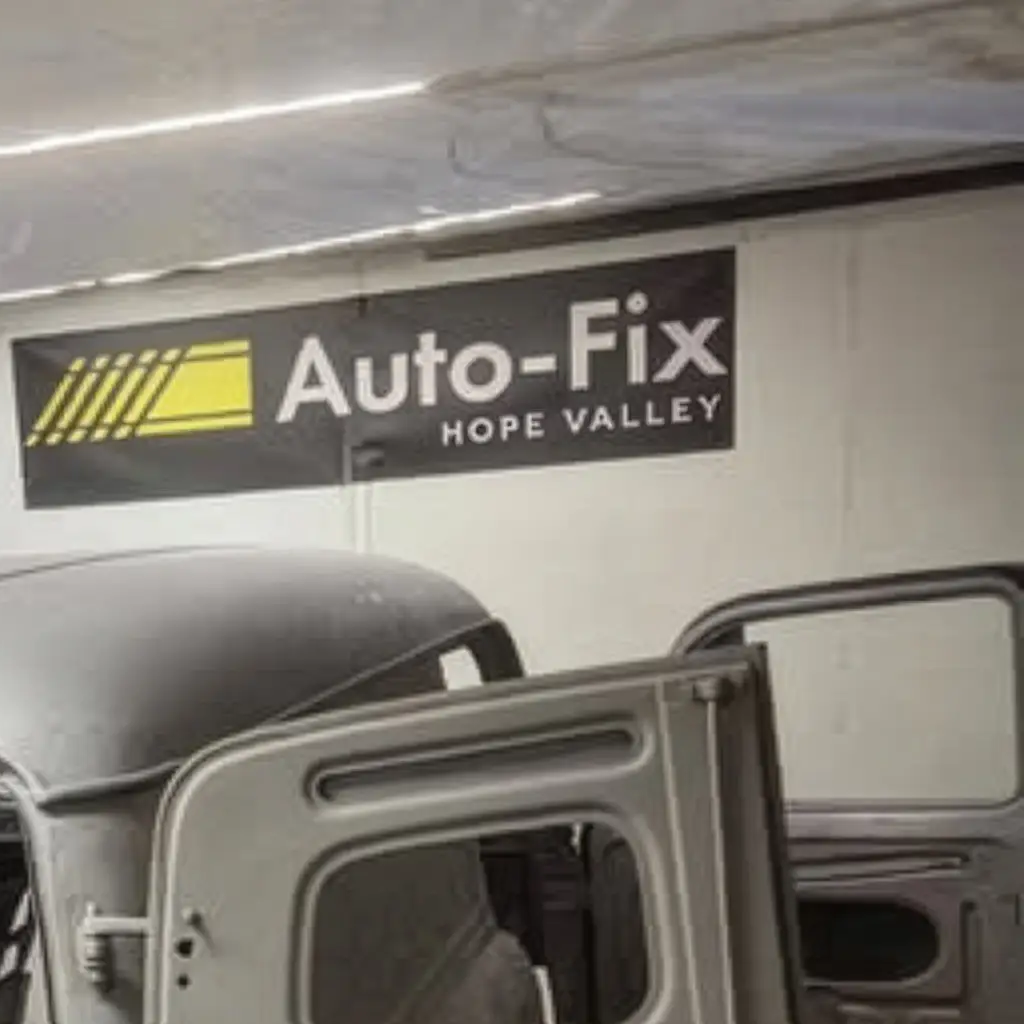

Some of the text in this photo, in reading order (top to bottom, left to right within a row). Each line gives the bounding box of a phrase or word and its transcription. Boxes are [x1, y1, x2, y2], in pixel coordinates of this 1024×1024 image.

[276, 292, 727, 424] Auto-Fix
[441, 395, 722, 447] HOPE VALLEY
